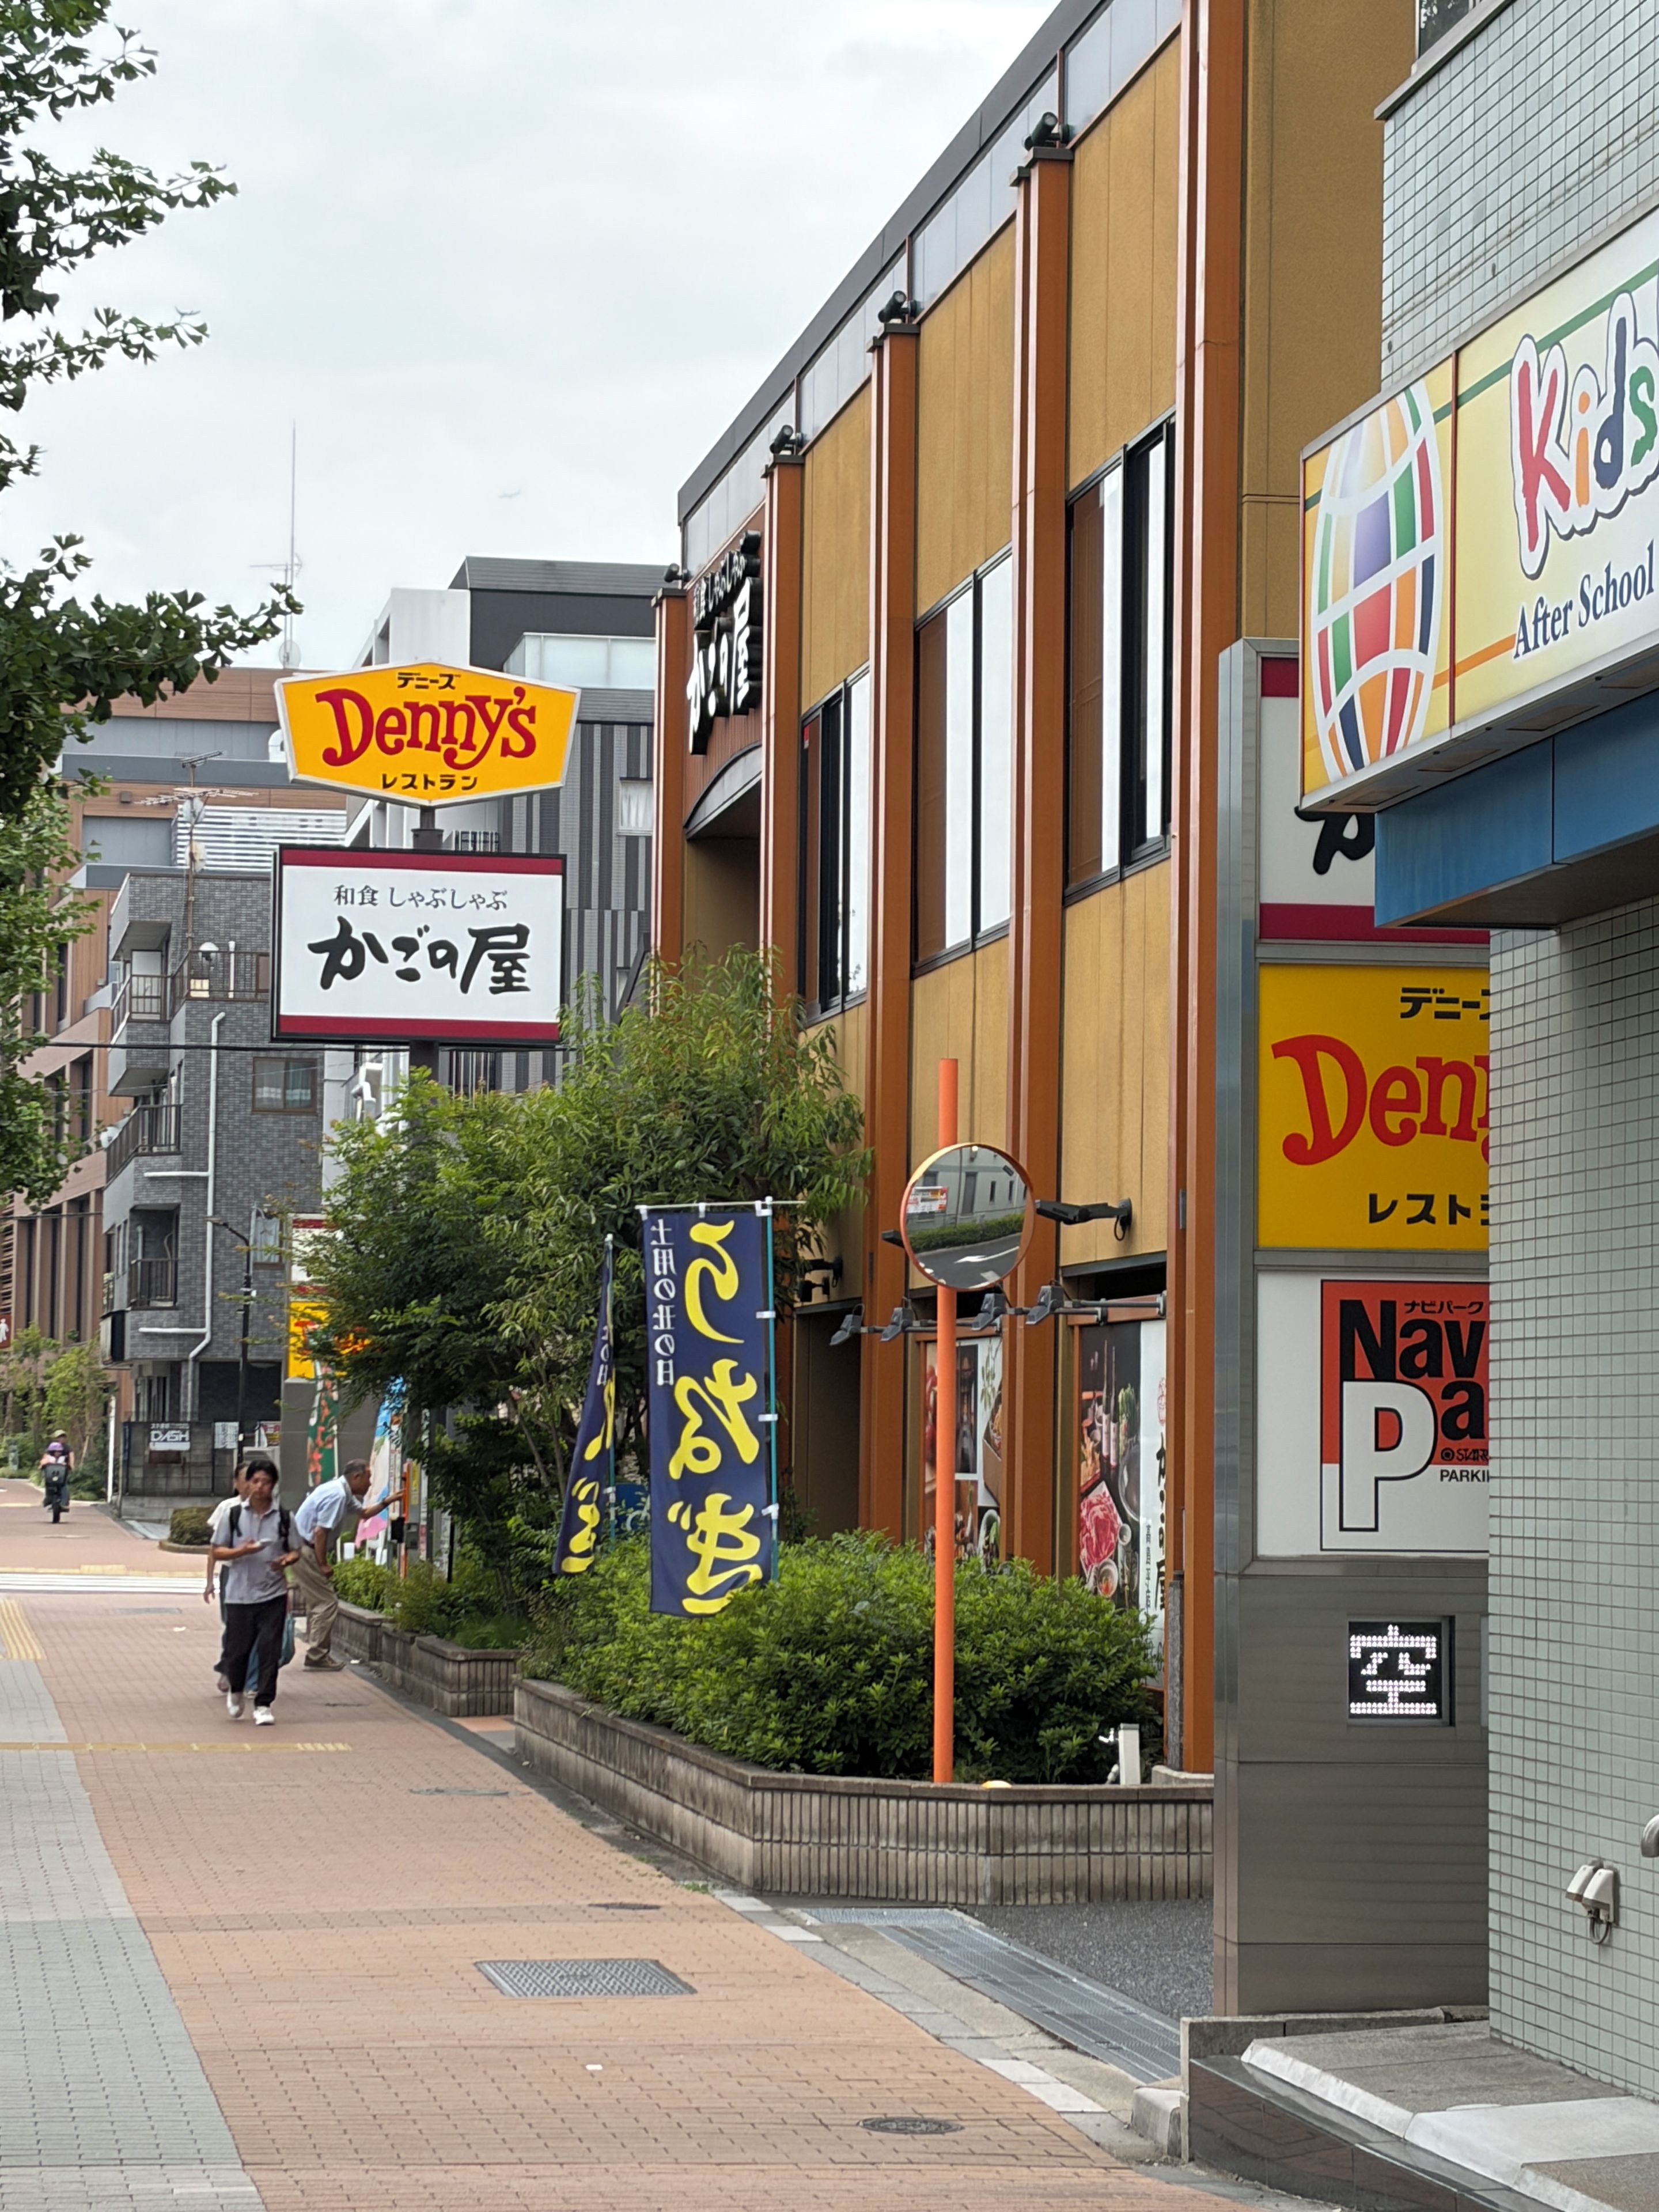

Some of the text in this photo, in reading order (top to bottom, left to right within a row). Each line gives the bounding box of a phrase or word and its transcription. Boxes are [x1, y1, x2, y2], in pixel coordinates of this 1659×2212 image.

[1517, 316, 1658, 553] Kids
[1513, 537, 1654, 660] After School
[397, 672, 461, 691] デニーズ
[687, 577, 751, 754] かごの屋
[315, 685, 537, 771] Denny's
[381, 773, 478, 791] レストラン
[333, 884, 508, 911] 和食 しゃぶしゃぶ
[307, 915, 531, 995] かごの屋
[1404, 1300, 1484, 1315] ナビパーク
[150, 1430, 190, 1441] DASH
[1440, 1469, 1490, 1483] PARKI
[1350, 1624, 1437, 1715] 空
